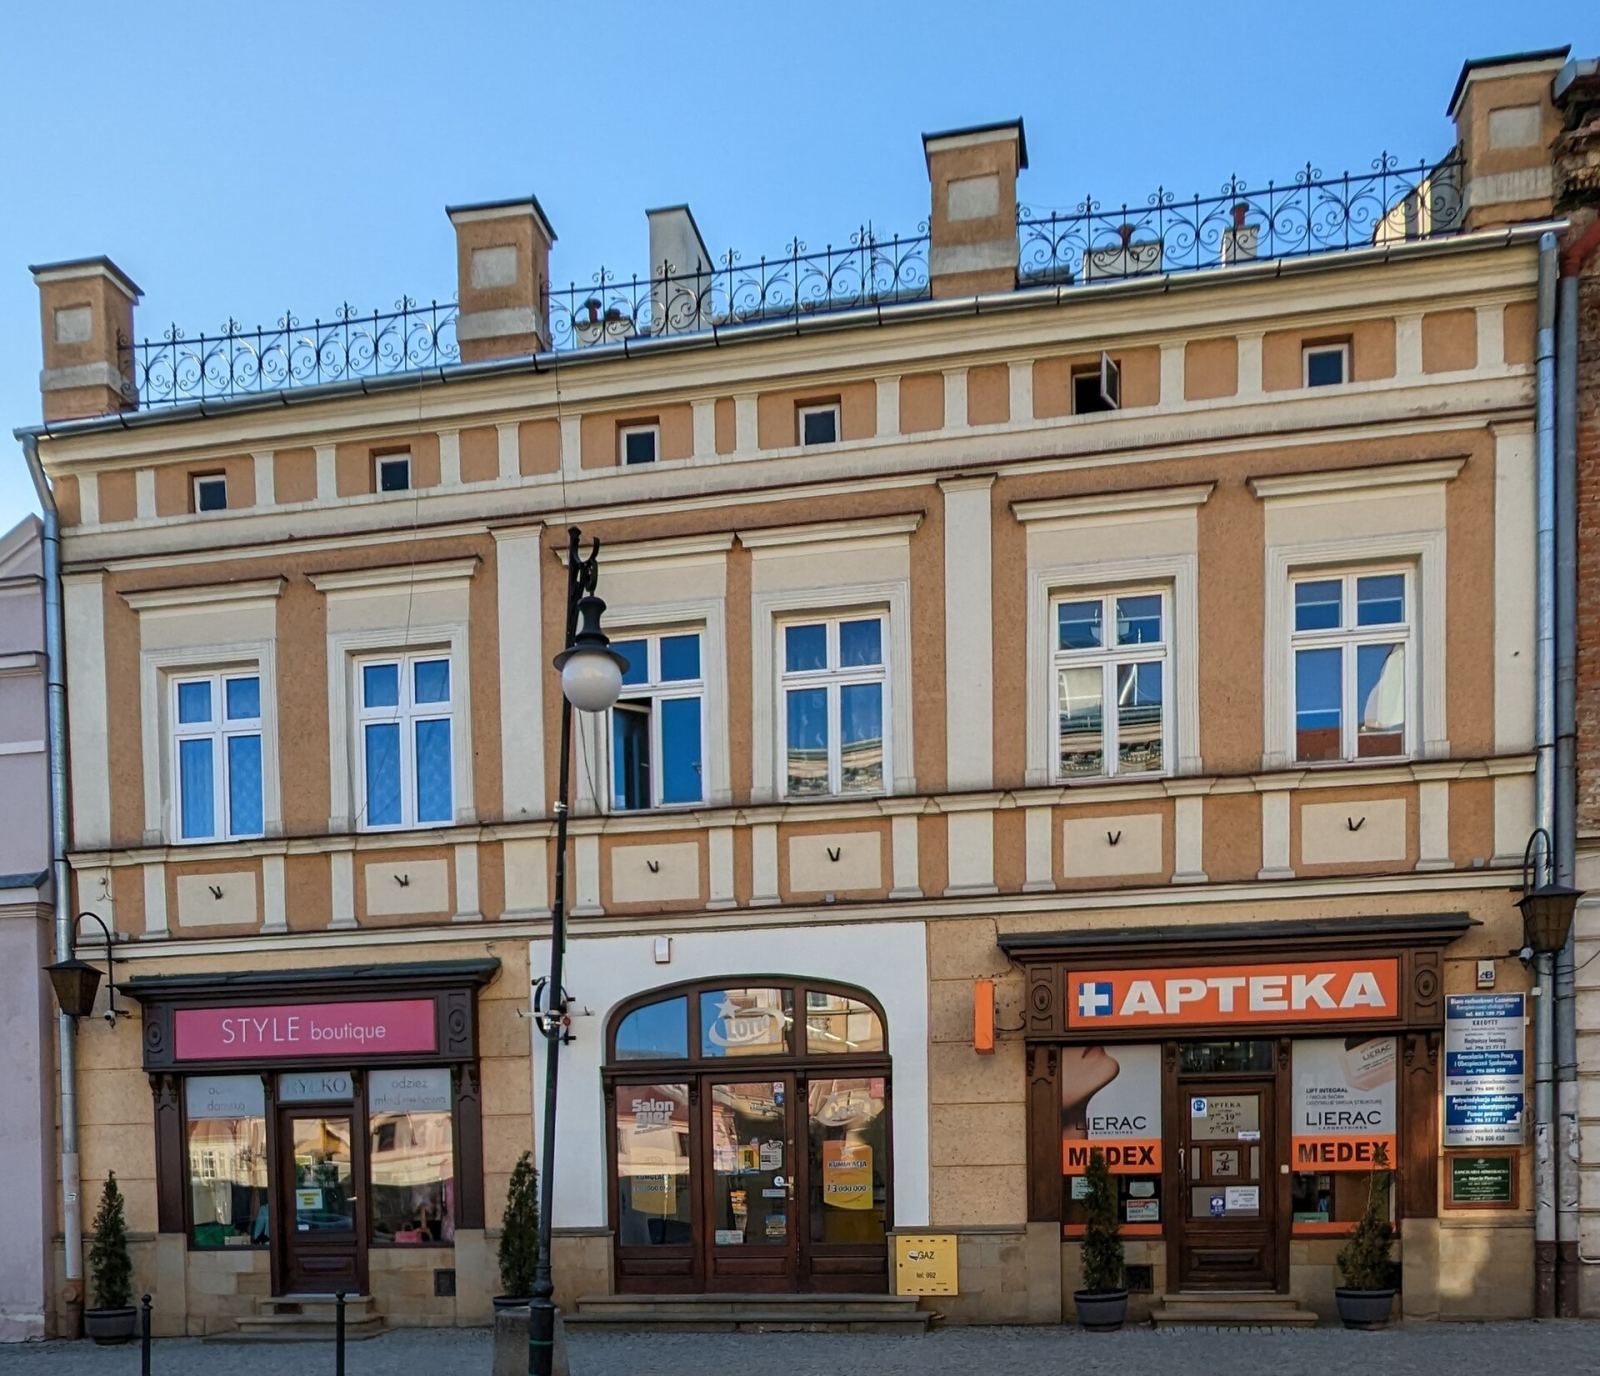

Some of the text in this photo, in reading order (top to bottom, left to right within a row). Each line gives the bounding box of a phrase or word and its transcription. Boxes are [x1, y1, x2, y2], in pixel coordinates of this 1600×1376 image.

[1119, 971, 1386, 1016] APTEKA
[222, 1016, 386, 1044] STYLE boutique
[632, 1098, 674, 1112] Salon
[635, 1112, 672, 1129] gier
[1076, 1116, 1147, 1130] LIERAC
[1306, 1110, 1382, 1126] LIERAC
[1298, 1141, 1390, 1163] MEDEX
[918, 1250, 935, 1260] GAZ
